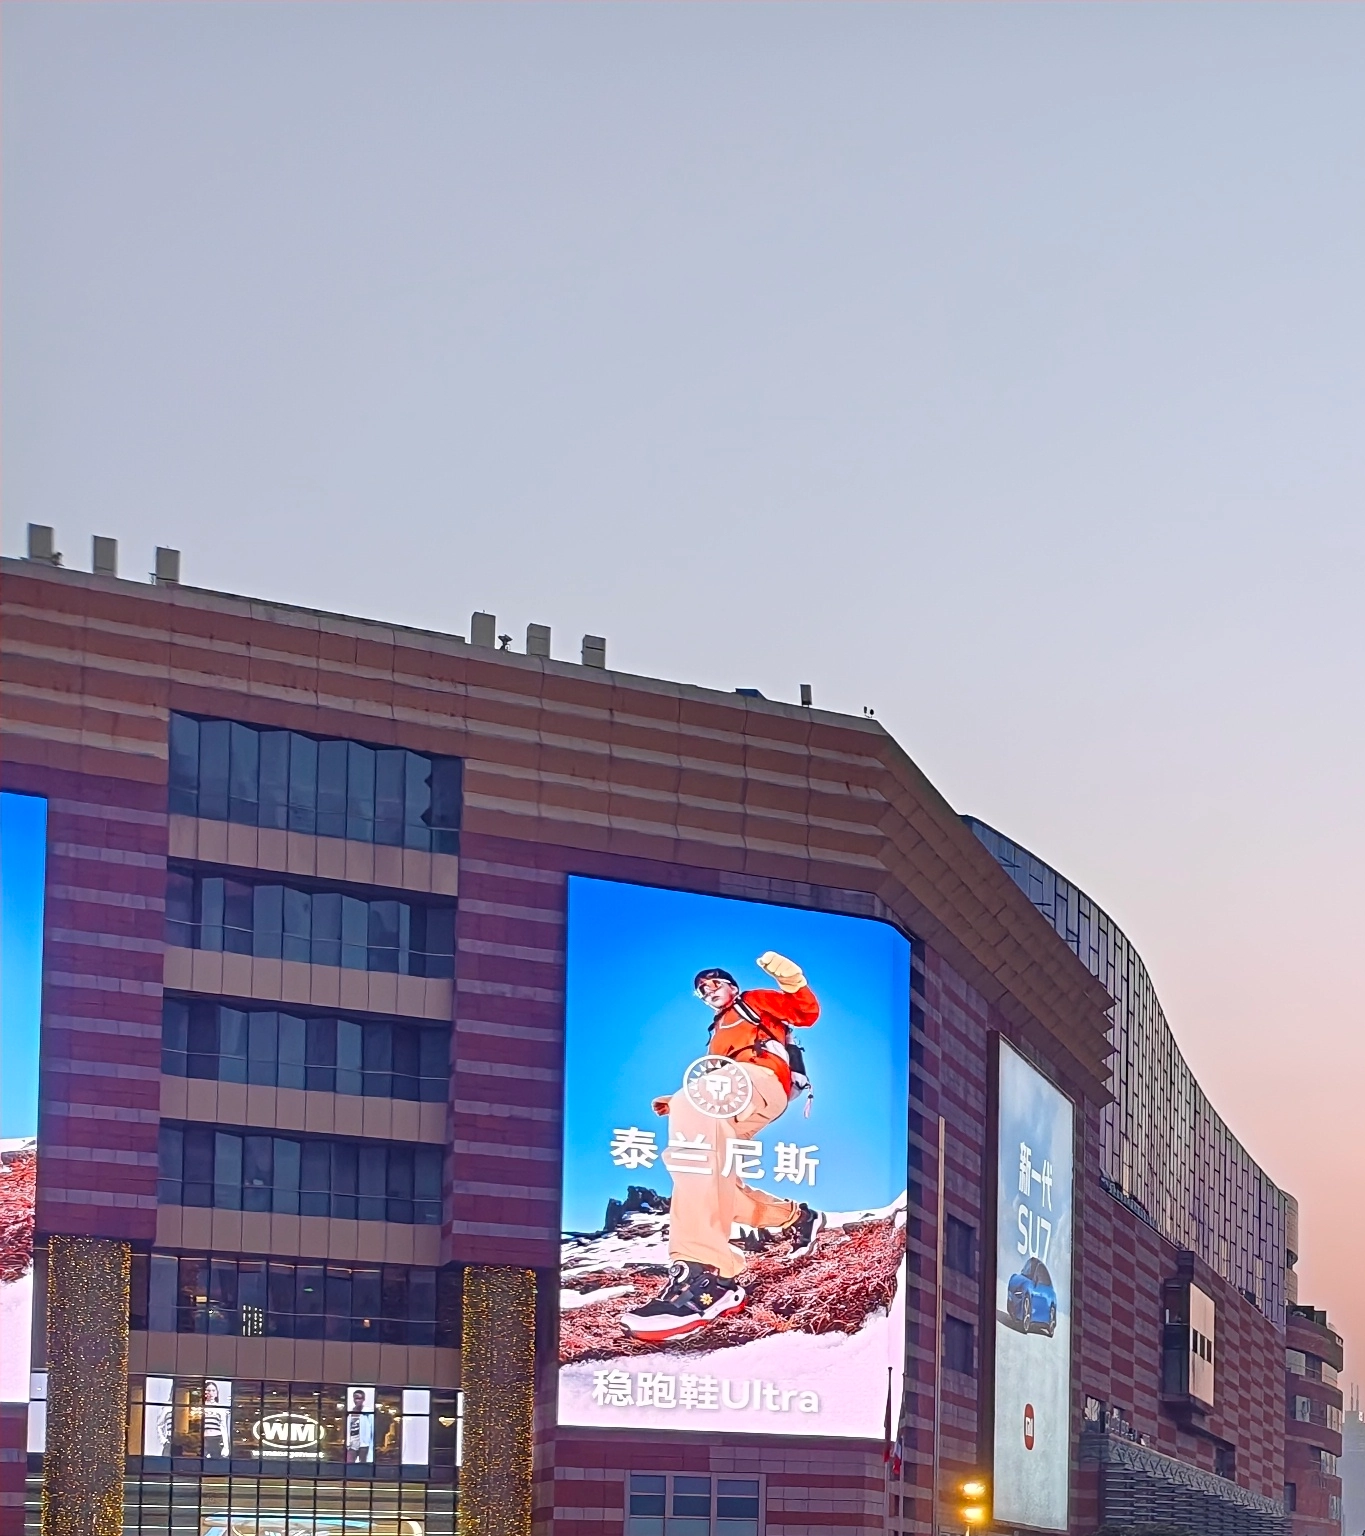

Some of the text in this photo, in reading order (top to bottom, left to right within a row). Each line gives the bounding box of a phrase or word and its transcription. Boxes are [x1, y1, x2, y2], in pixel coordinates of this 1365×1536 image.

[610, 1126, 820, 1186] 泰兰尼斯
[1018, 1141, 1053, 1213] 新一代
[1017, 1203, 1052, 1264] SU7
[591, 1368, 821, 1414] 稳跑鞋Ultra
[262, 1421, 316, 1442] WM
